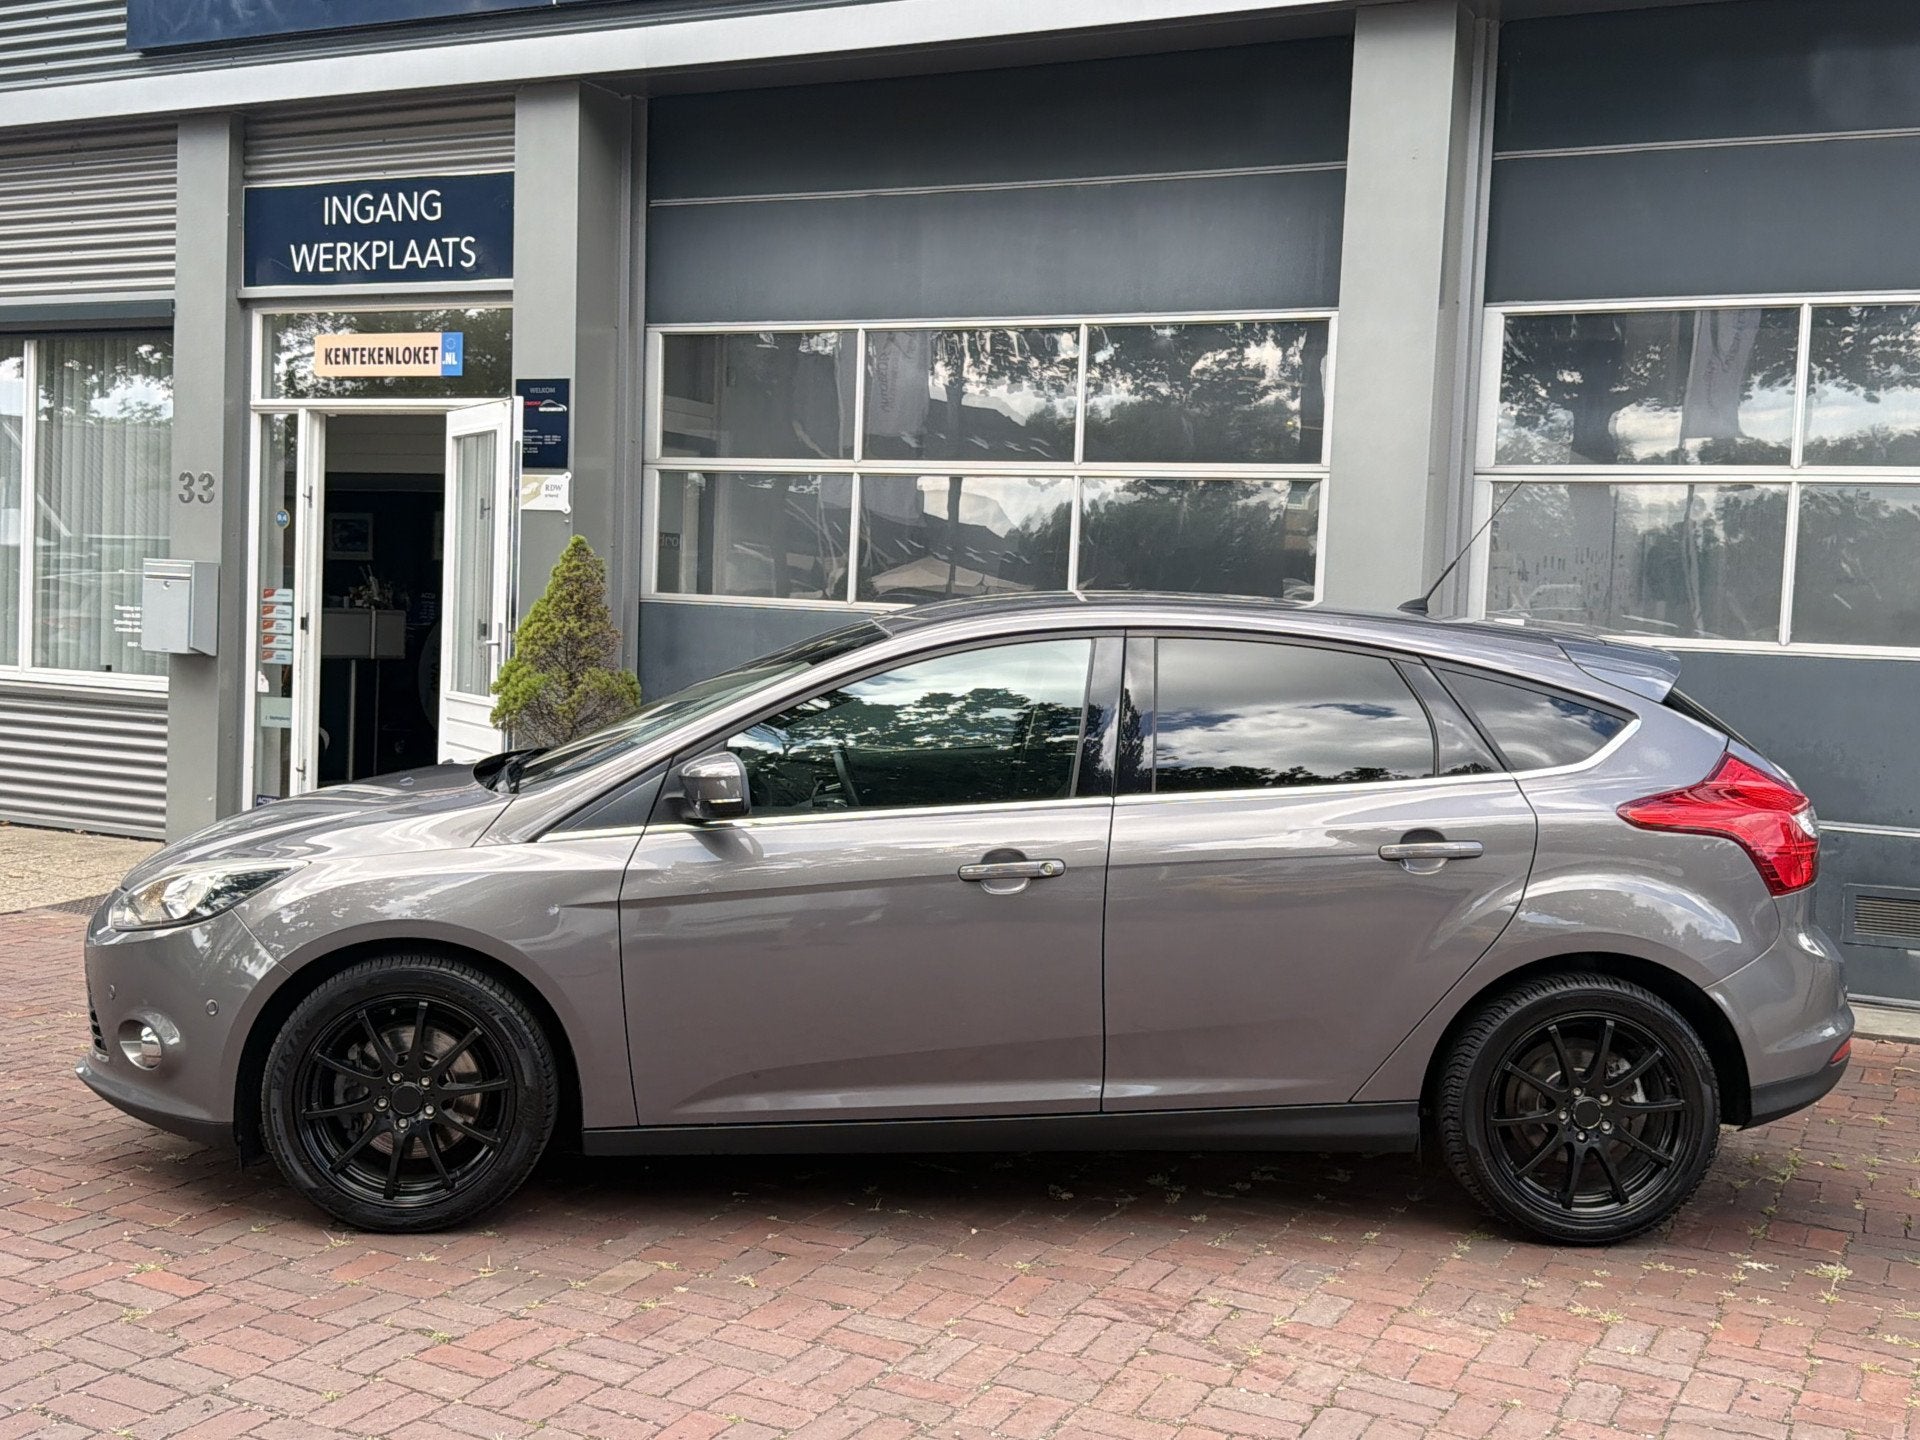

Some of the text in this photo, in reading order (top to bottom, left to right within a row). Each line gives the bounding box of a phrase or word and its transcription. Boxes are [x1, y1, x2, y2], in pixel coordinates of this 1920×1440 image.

[323, 189, 442, 225] INGANG
[290, 236, 477, 273] WERKPLAATS
[324, 346, 458, 366] KENTEKENLOKET .NL
[178, 471, 216, 504] 33
[545, 484, 564, 492] RDW
